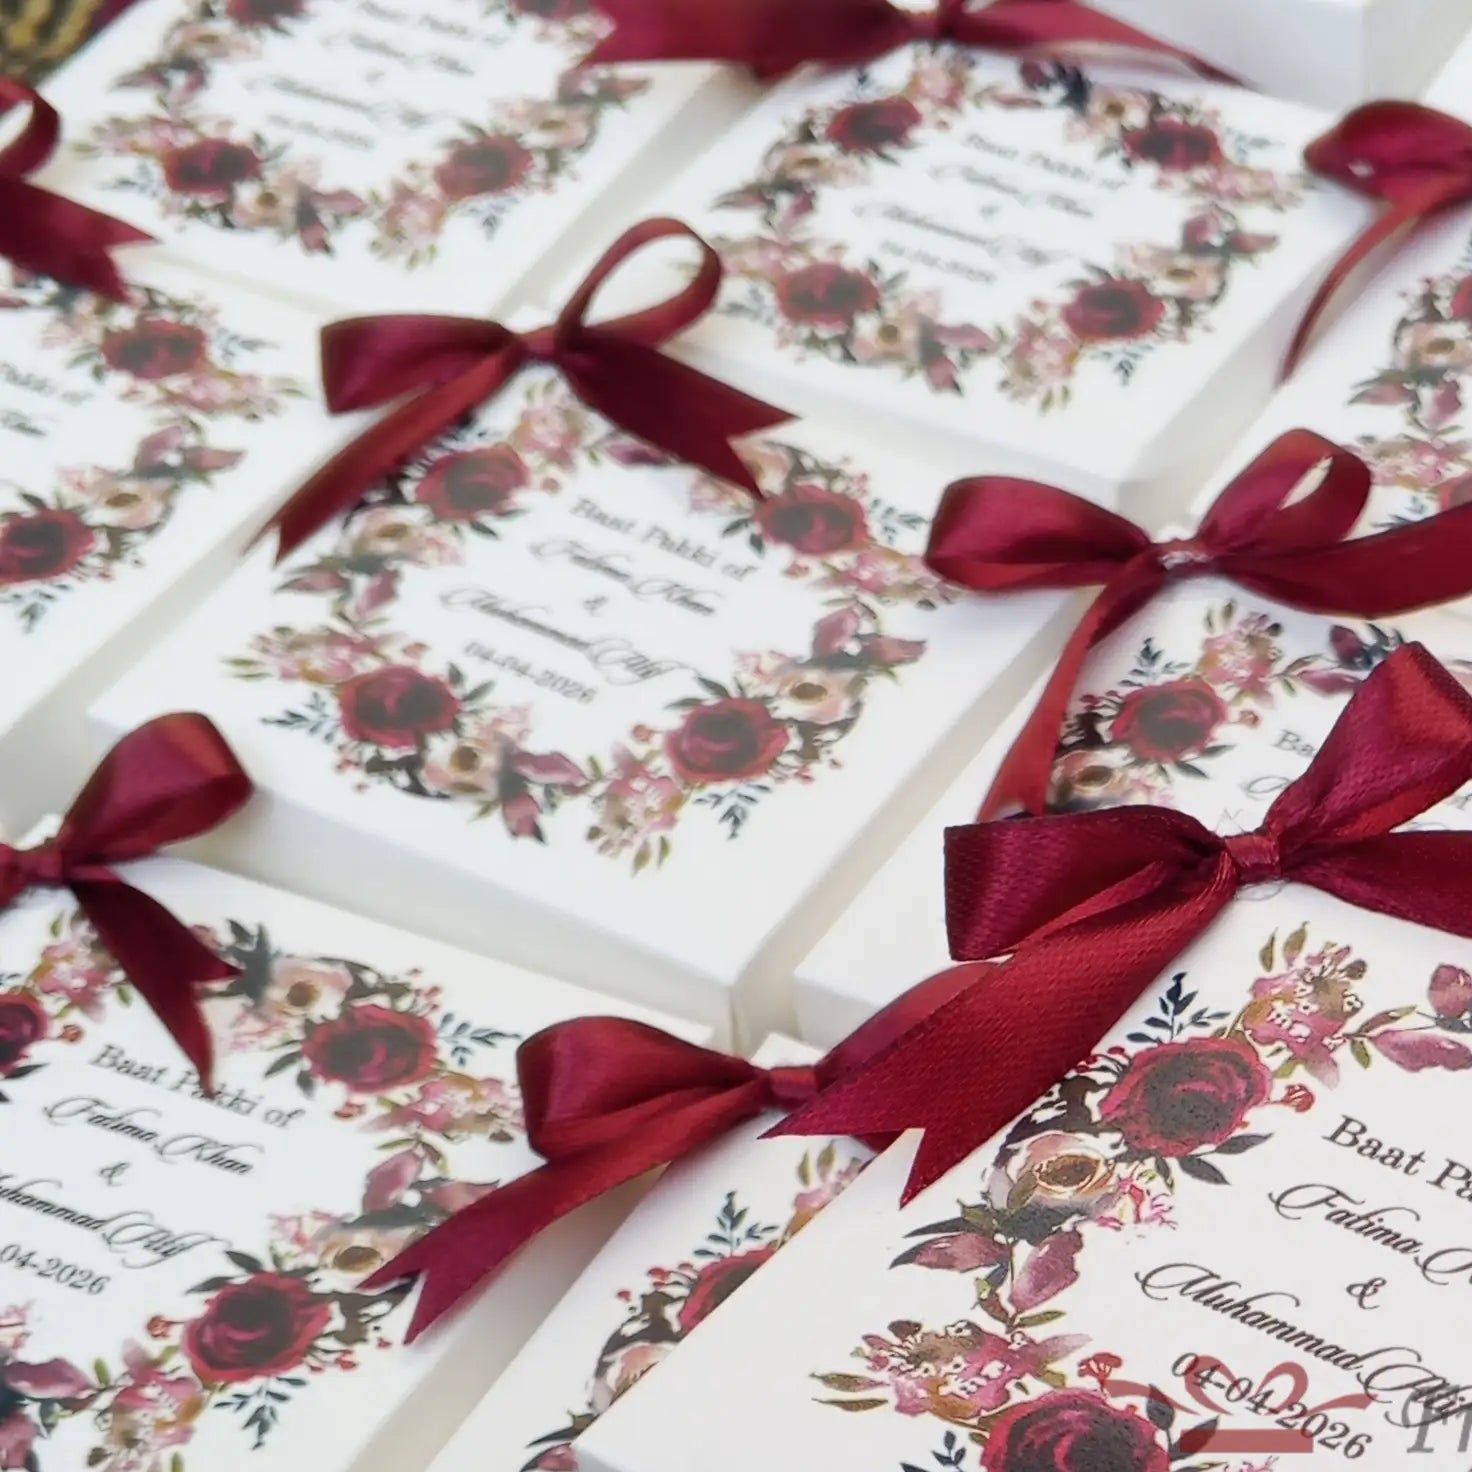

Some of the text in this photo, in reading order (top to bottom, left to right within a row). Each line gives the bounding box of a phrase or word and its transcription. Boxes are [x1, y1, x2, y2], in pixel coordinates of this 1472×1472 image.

[89, 1043, 167, 1085] Baat
[263, 1107, 305, 1129] of
[1321, 1114, 1427, 1178] Baat
[1269, 1183, 1421, 1256] Fatima
[1136, 1262, 1422, 1373] Muhammad
[1346, 1277, 1386, 1309] &
[1171, 1352, 1373, 1459] 04-04-2026
